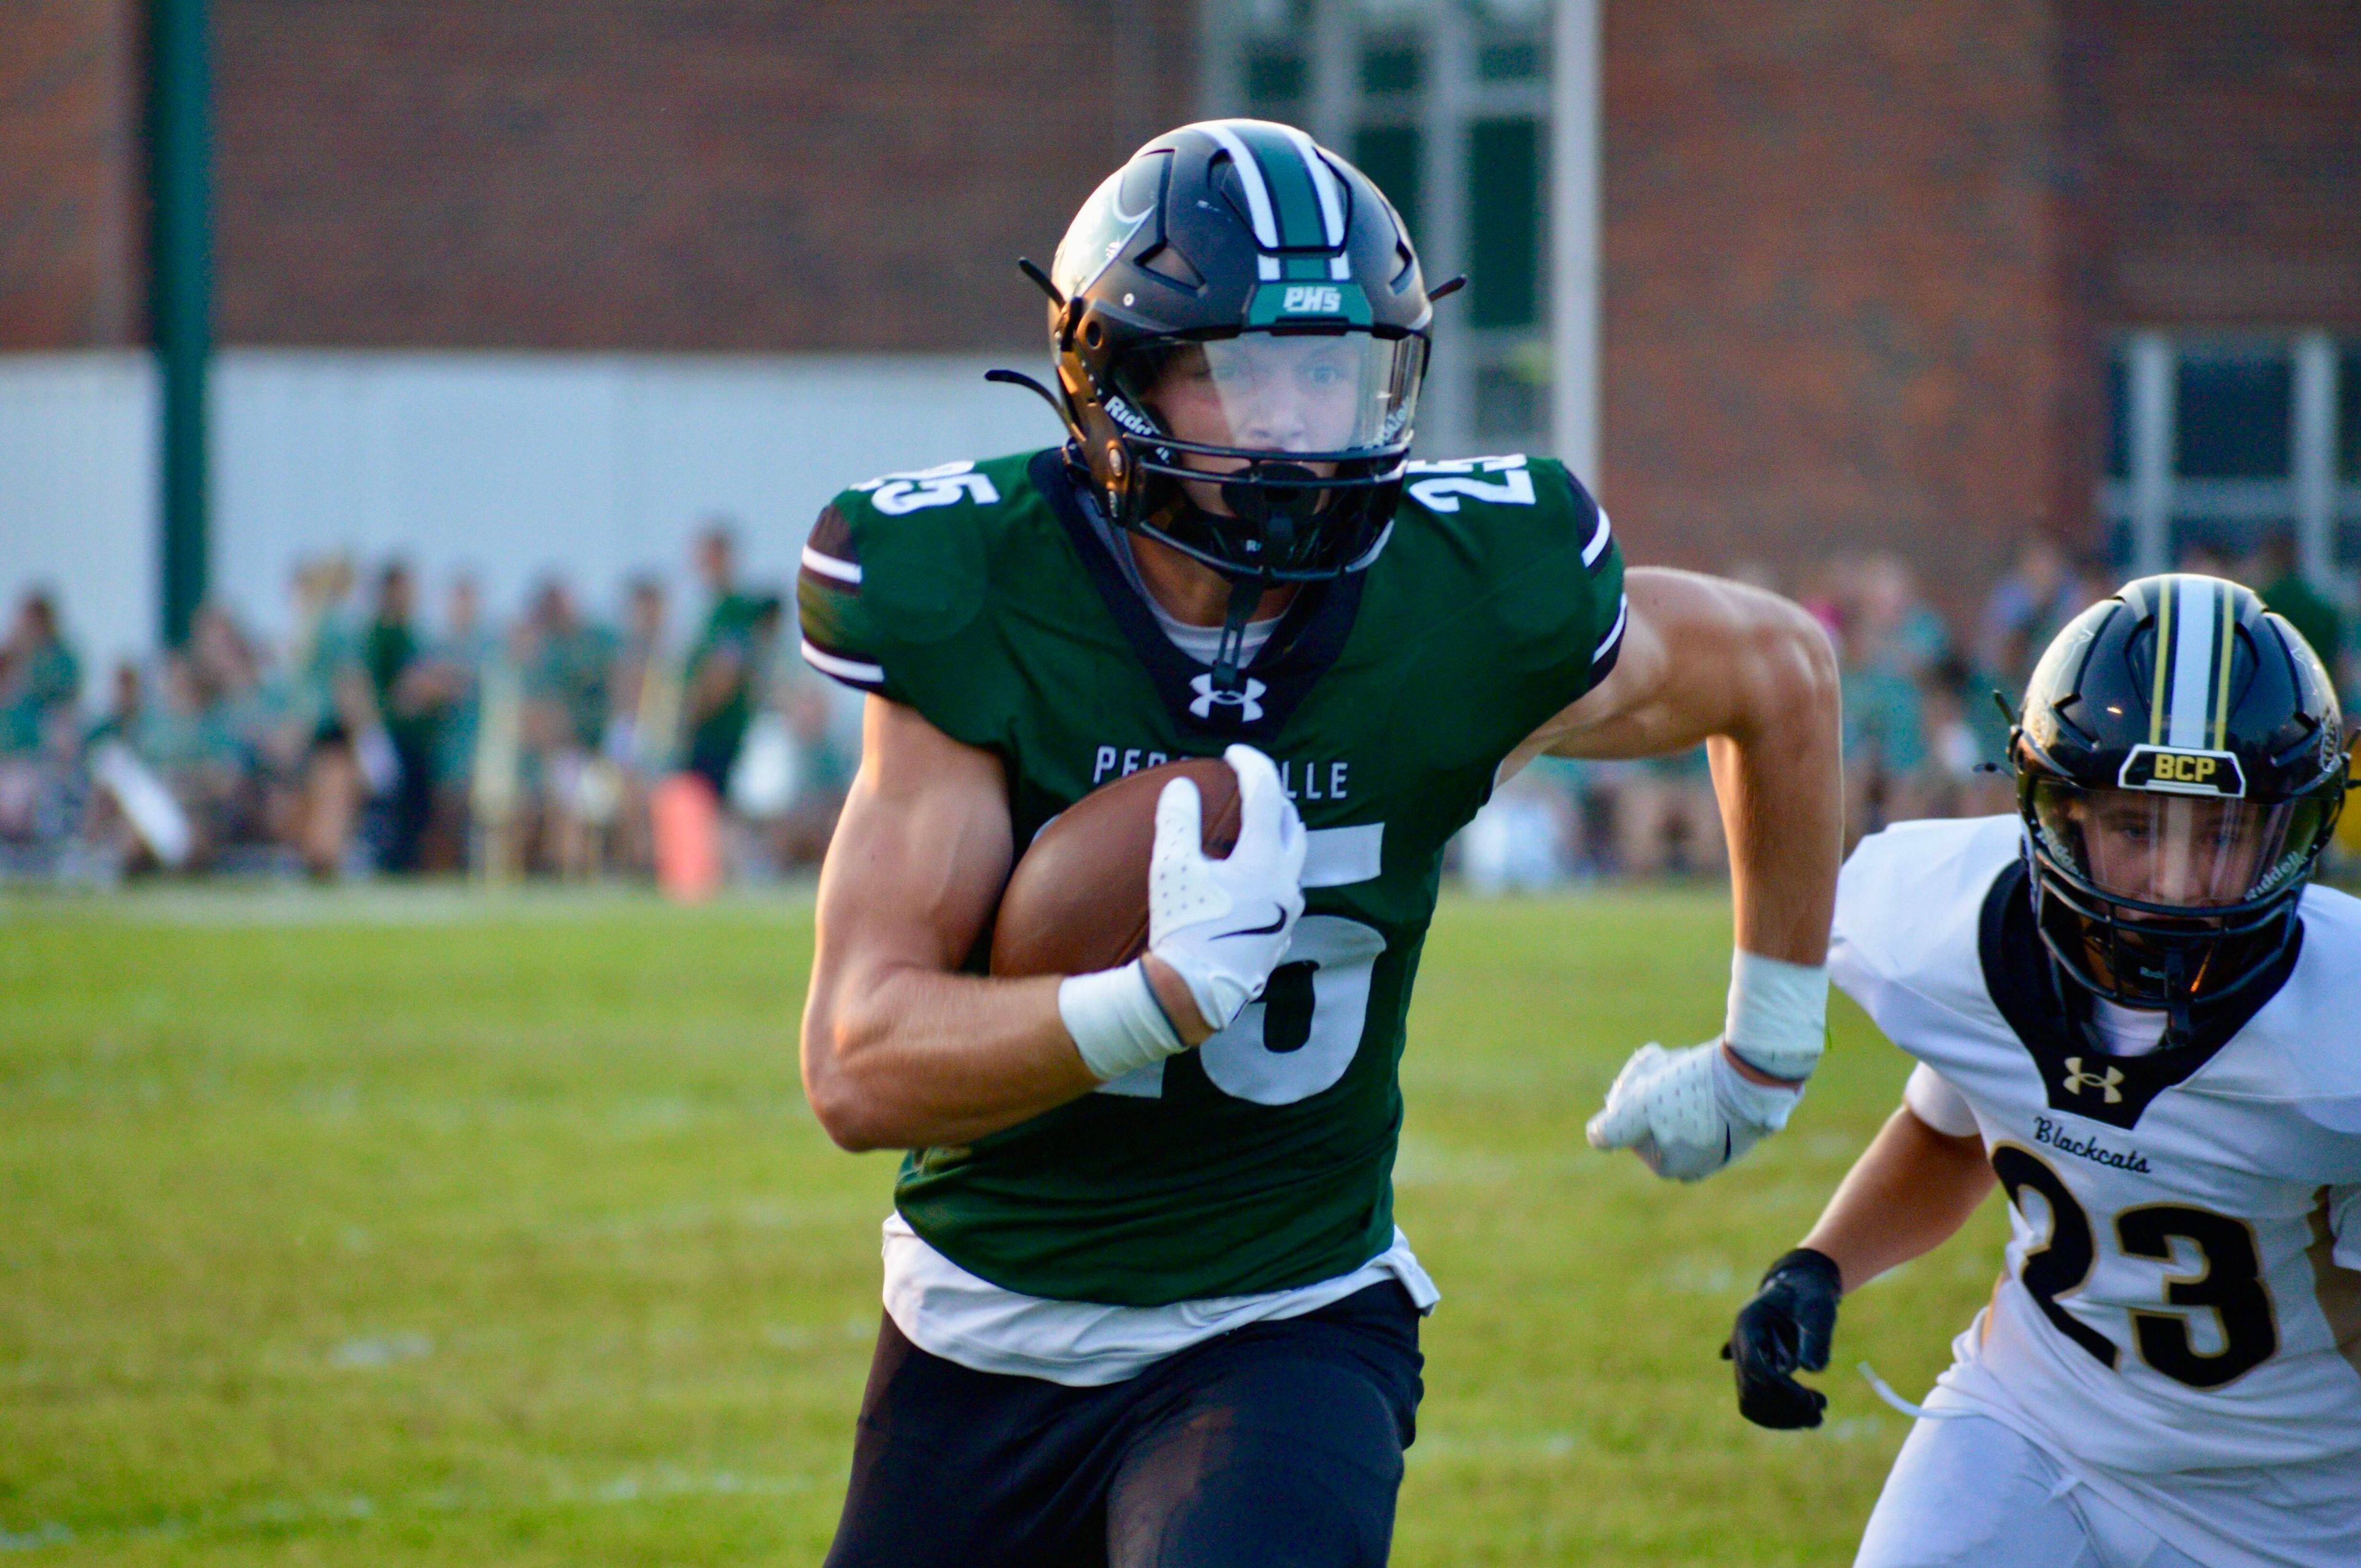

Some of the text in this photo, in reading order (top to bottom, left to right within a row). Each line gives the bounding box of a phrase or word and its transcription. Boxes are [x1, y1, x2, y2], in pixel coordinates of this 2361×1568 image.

[1283, 286, 1342, 312] PHS
[2154, 753, 2216, 782] BCP
[2034, 1116, 2151, 1173] Blackcats
[1990, 1139, 2280, 1392] 23
